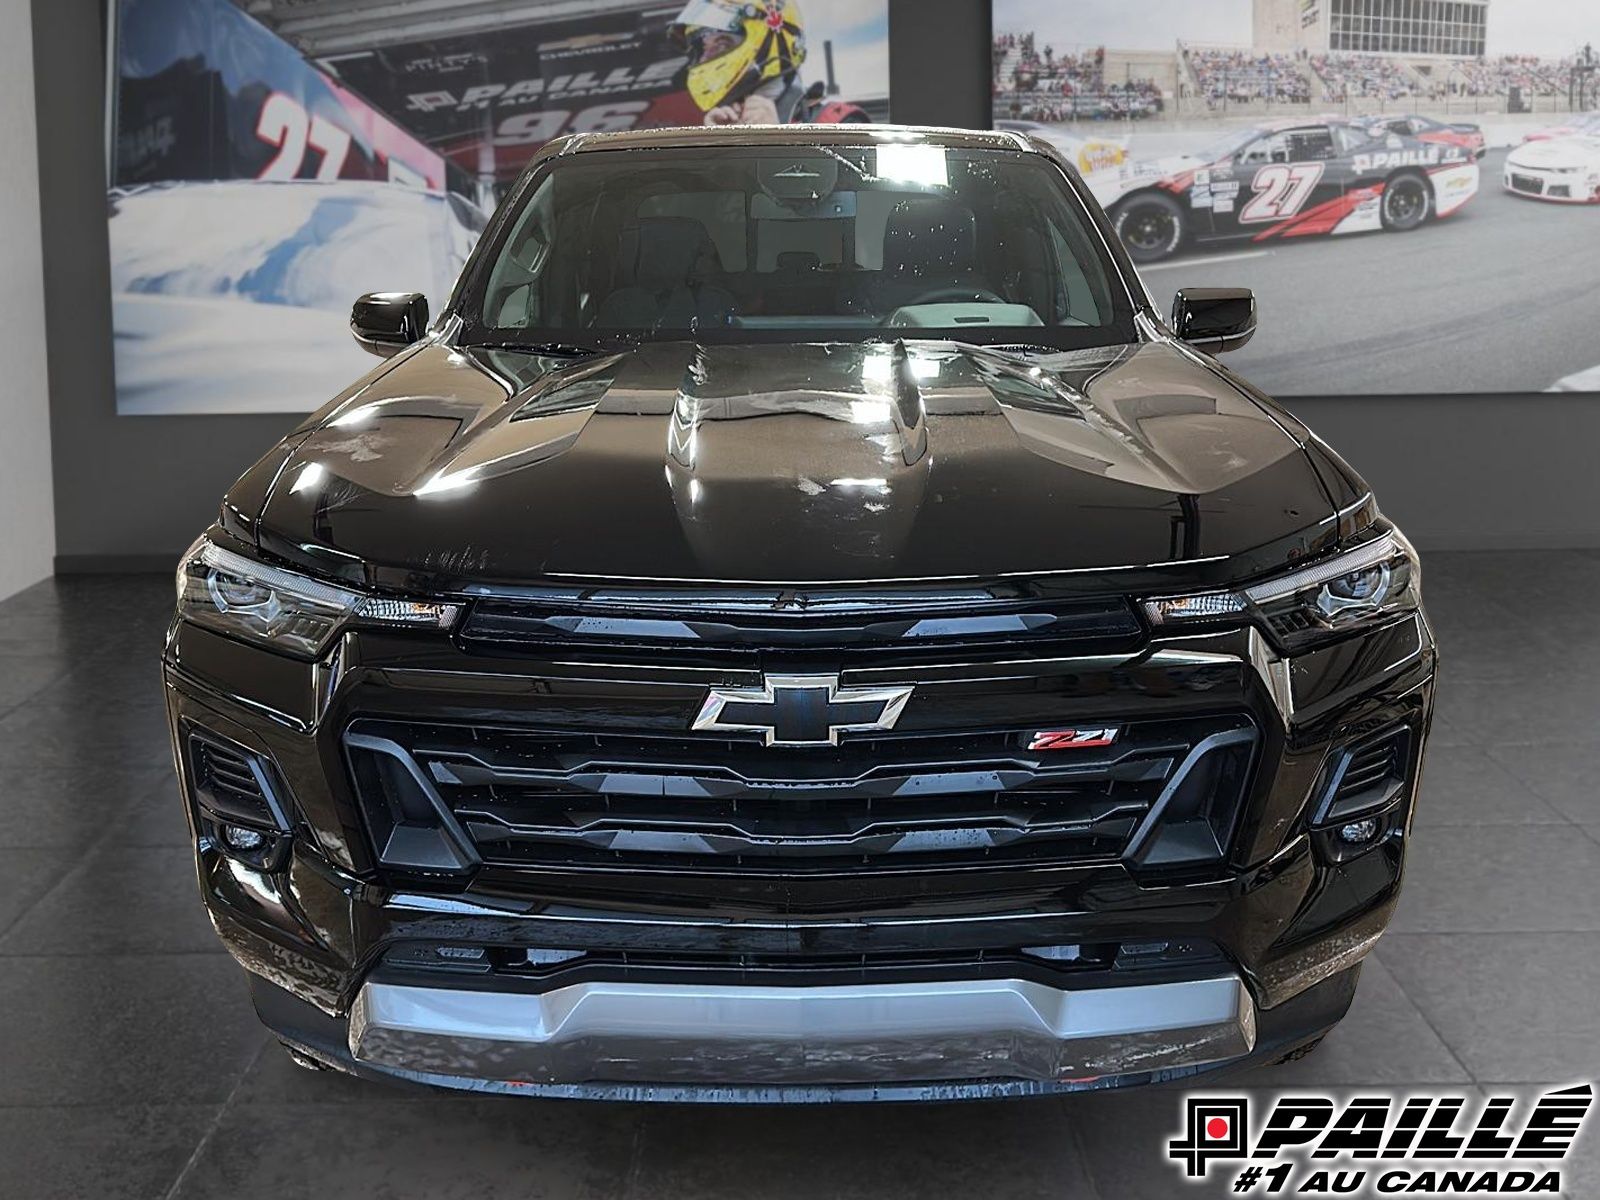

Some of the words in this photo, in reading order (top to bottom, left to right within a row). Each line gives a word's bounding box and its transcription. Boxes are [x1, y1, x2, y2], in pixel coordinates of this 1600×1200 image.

[540, 41, 641, 60] CHEVROLET
[549, 79, 672, 100] CANADA
[256, 91, 351, 182] 27
[493, 101, 649, 146] 96
[1238, 161, 1326, 224] 27
[1027, 728, 1119, 750] Z71
